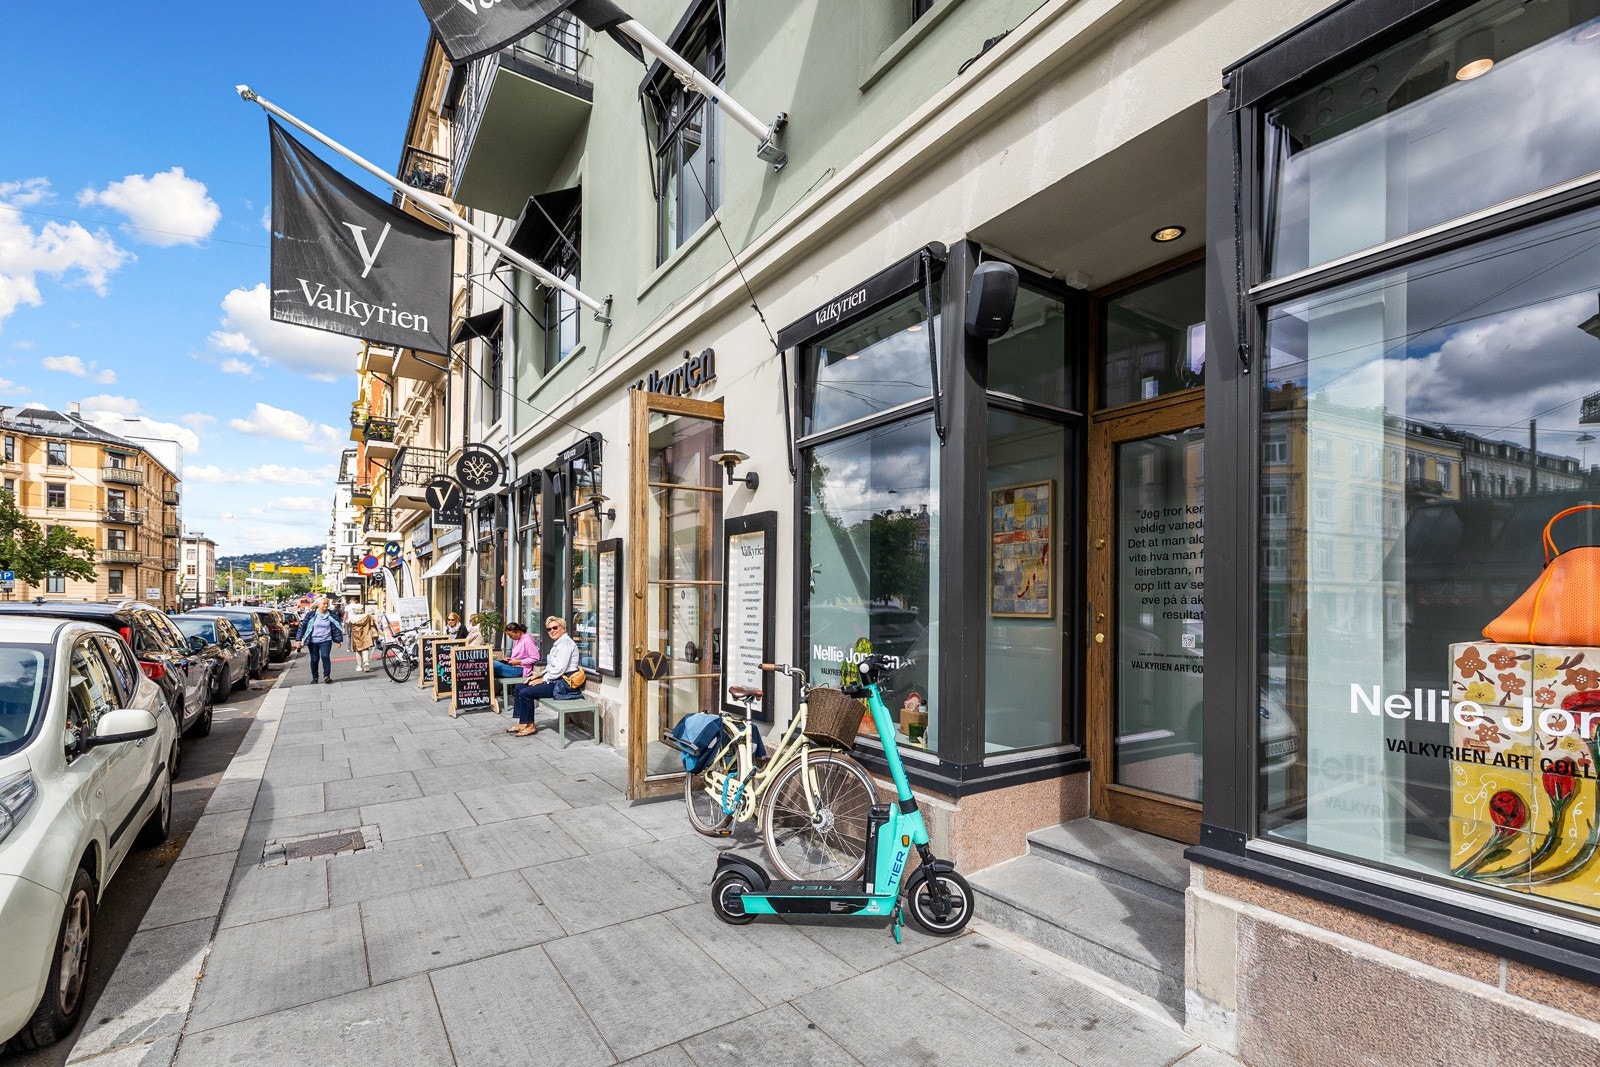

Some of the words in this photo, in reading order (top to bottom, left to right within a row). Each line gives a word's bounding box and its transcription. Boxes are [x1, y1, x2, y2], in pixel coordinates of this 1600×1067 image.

[296, 277, 430, 333] Valkyrien
[815, 288, 866, 326] Valkyrien
[627, 347, 717, 397] lkyrien
[1136, 509, 1160, 520] "Jeg
[1163, 507, 1183, 517] tror
[1134, 523, 1165, 534] veldig
[1168, 519, 1203, 531] vaned
[1128, 539, 1146, 548] Det
[1148, 537, 1159, 547] at
[1162, 537, 1185, 546] man
[1128, 553, 1147, 562] vite
[1150, 552, 1169, 562] hva
[1172, 551, 1196, 560] man
[1135, 565, 1192, 576] leirebrann,
[1134, 582, 1154, 592] opp
[1157, 580, 1171, 590] litt
[1174, 582, 1187, 590] av
[1190, 581, 1204, 590] se
[1141, 597, 1160, 605] øve
[1163, 594, 1177, 606] på
[1180, 593, 1187, 604] å
[1190, 595, 1204, 605] ak
[1162, 610, 1204, 620] resultat
[813, 644, 844, 663] Nellie
[1131, 660, 1172, 671] VALKYRIEN
[1174, 663, 1190, 673] ART
[1192, 665, 1204, 674] CO
[1350, 683, 1484, 727] Nellie
[1386, 737, 1486, 765] VALKYRIEN
[1492, 752, 1533, 771] ART
[1540, 757, 1600, 780] COLL
[887, 850, 906, 888] TIER
